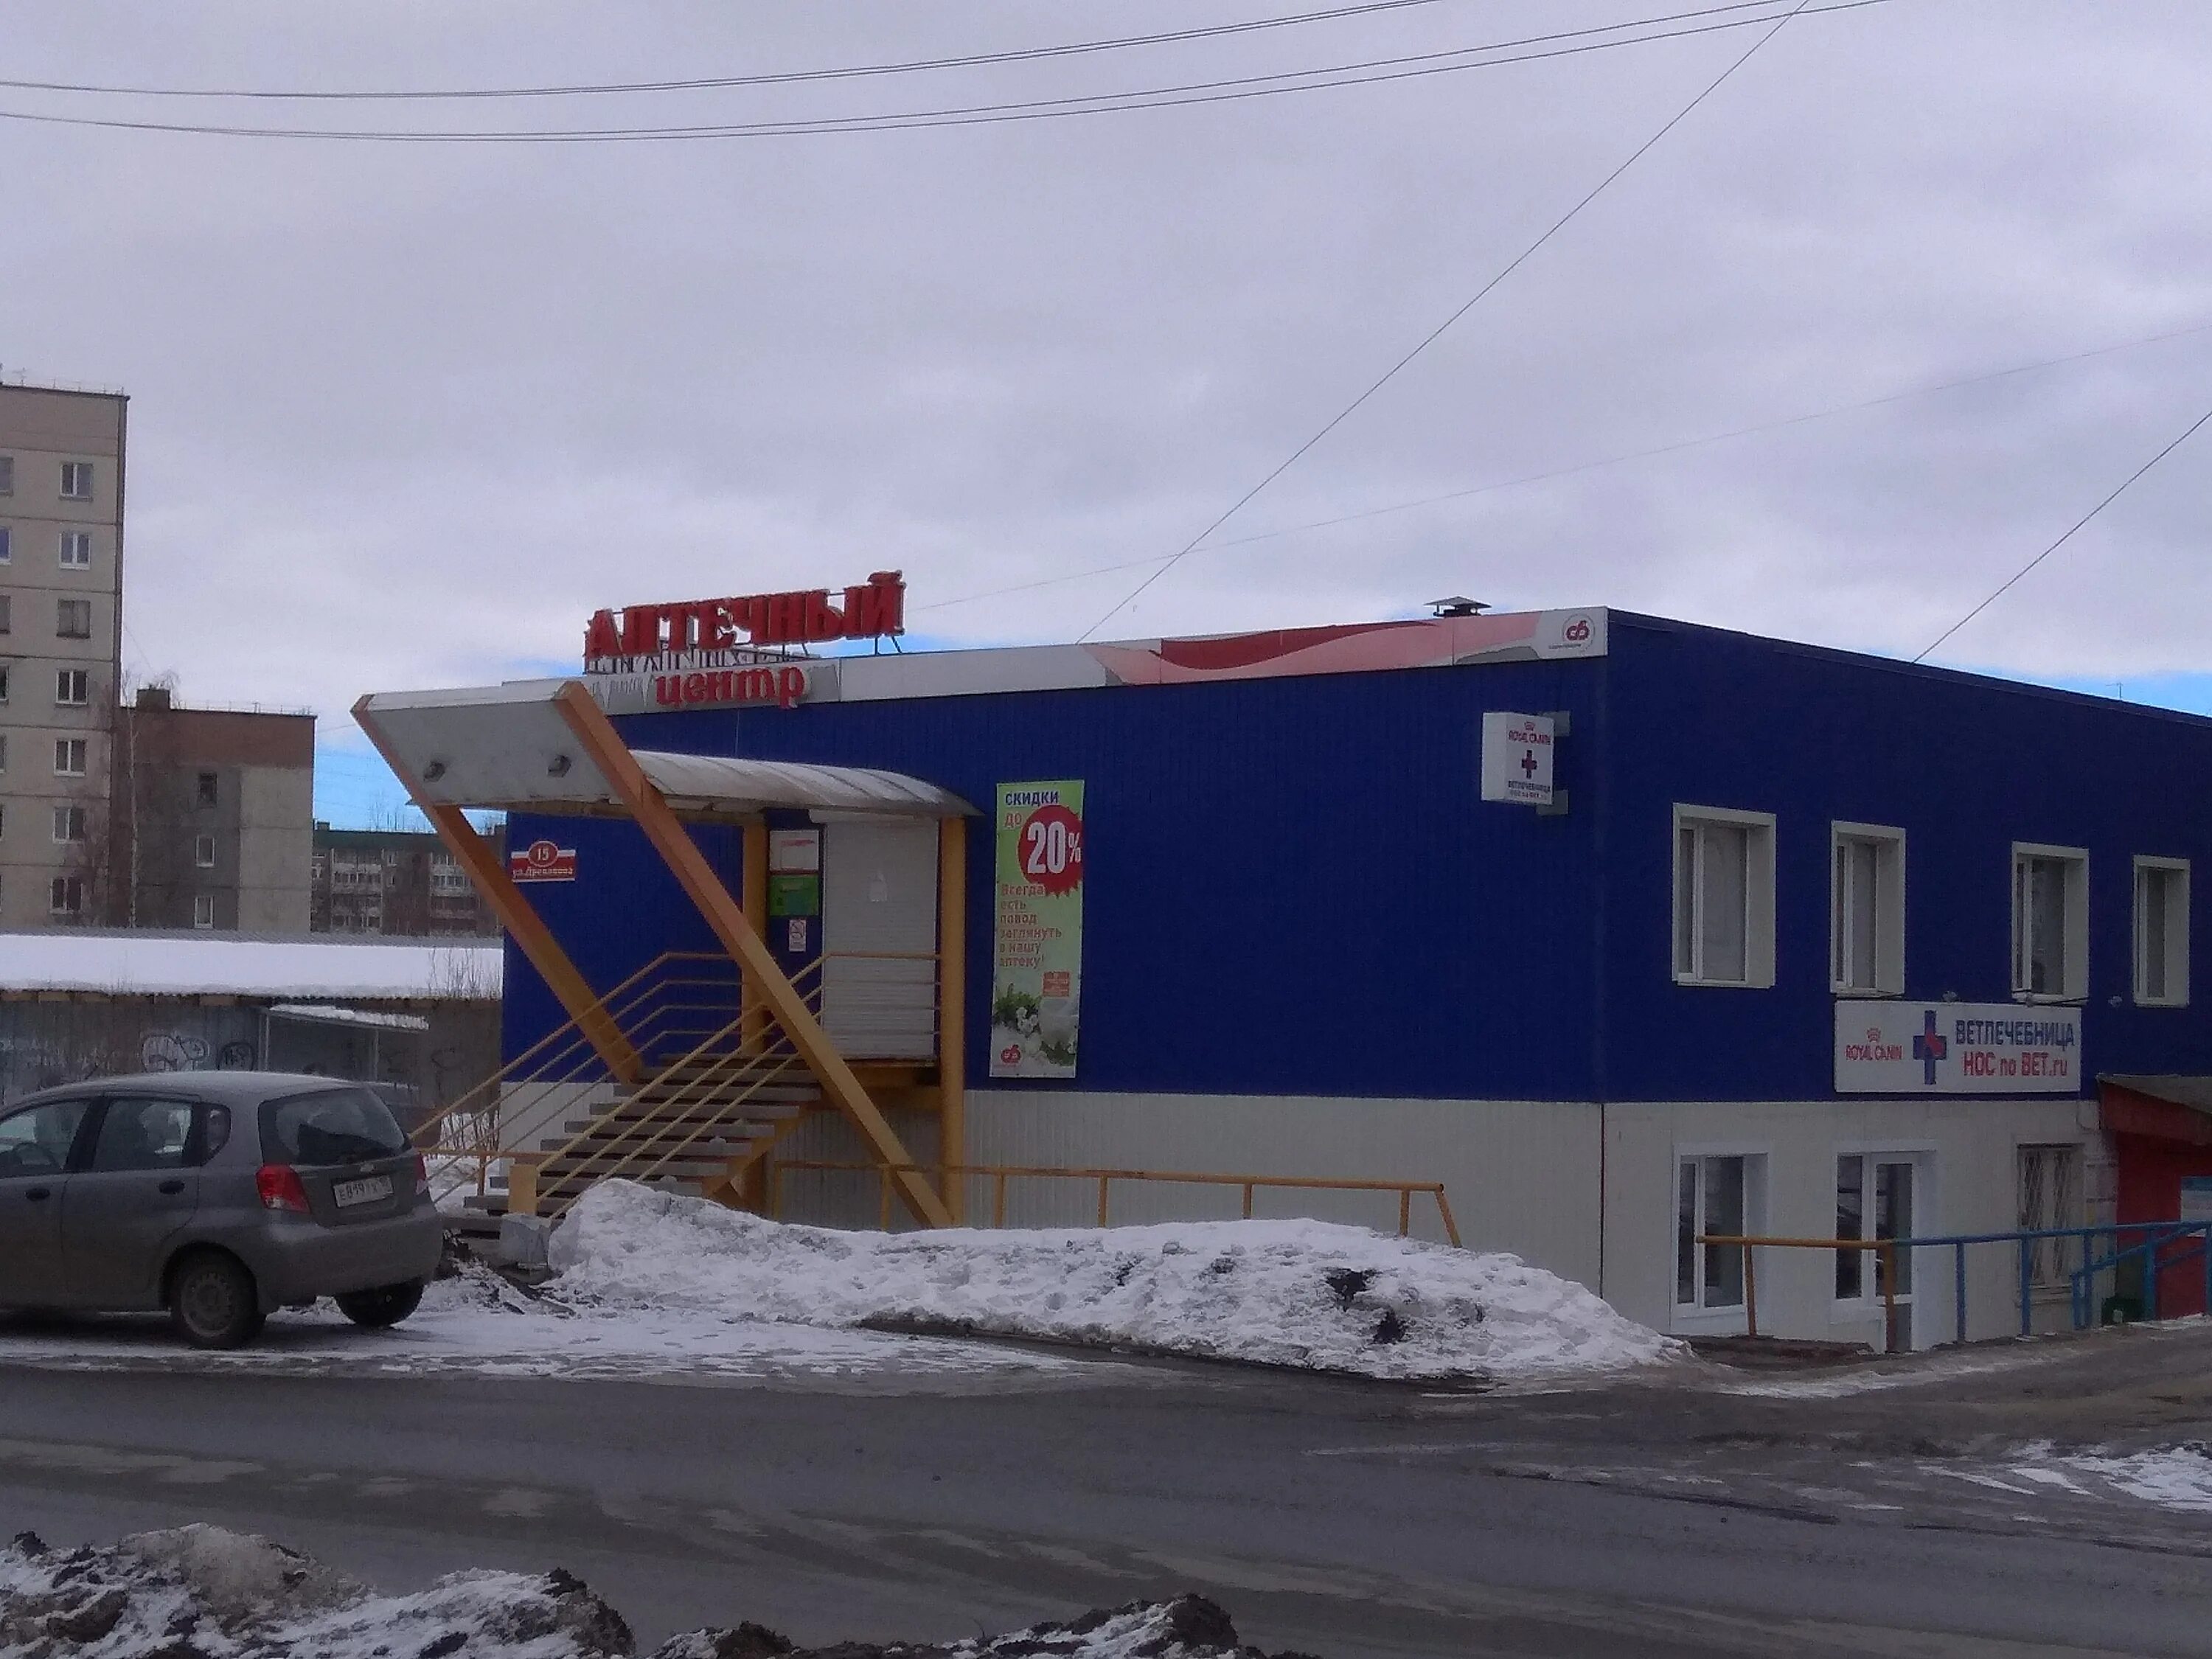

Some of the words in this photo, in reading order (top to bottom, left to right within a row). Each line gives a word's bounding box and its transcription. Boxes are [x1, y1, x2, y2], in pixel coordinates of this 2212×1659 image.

[584, 570, 906, 658] АПТЕЧНЫЙ
[656, 667, 807, 709] центр
[538, 848, 549, 860] 15
[1955, 1020, 2075, 1051] ВЕТЛЕЧЕБНИЦА
[1964, 1051, 1995, 1076] НОС
